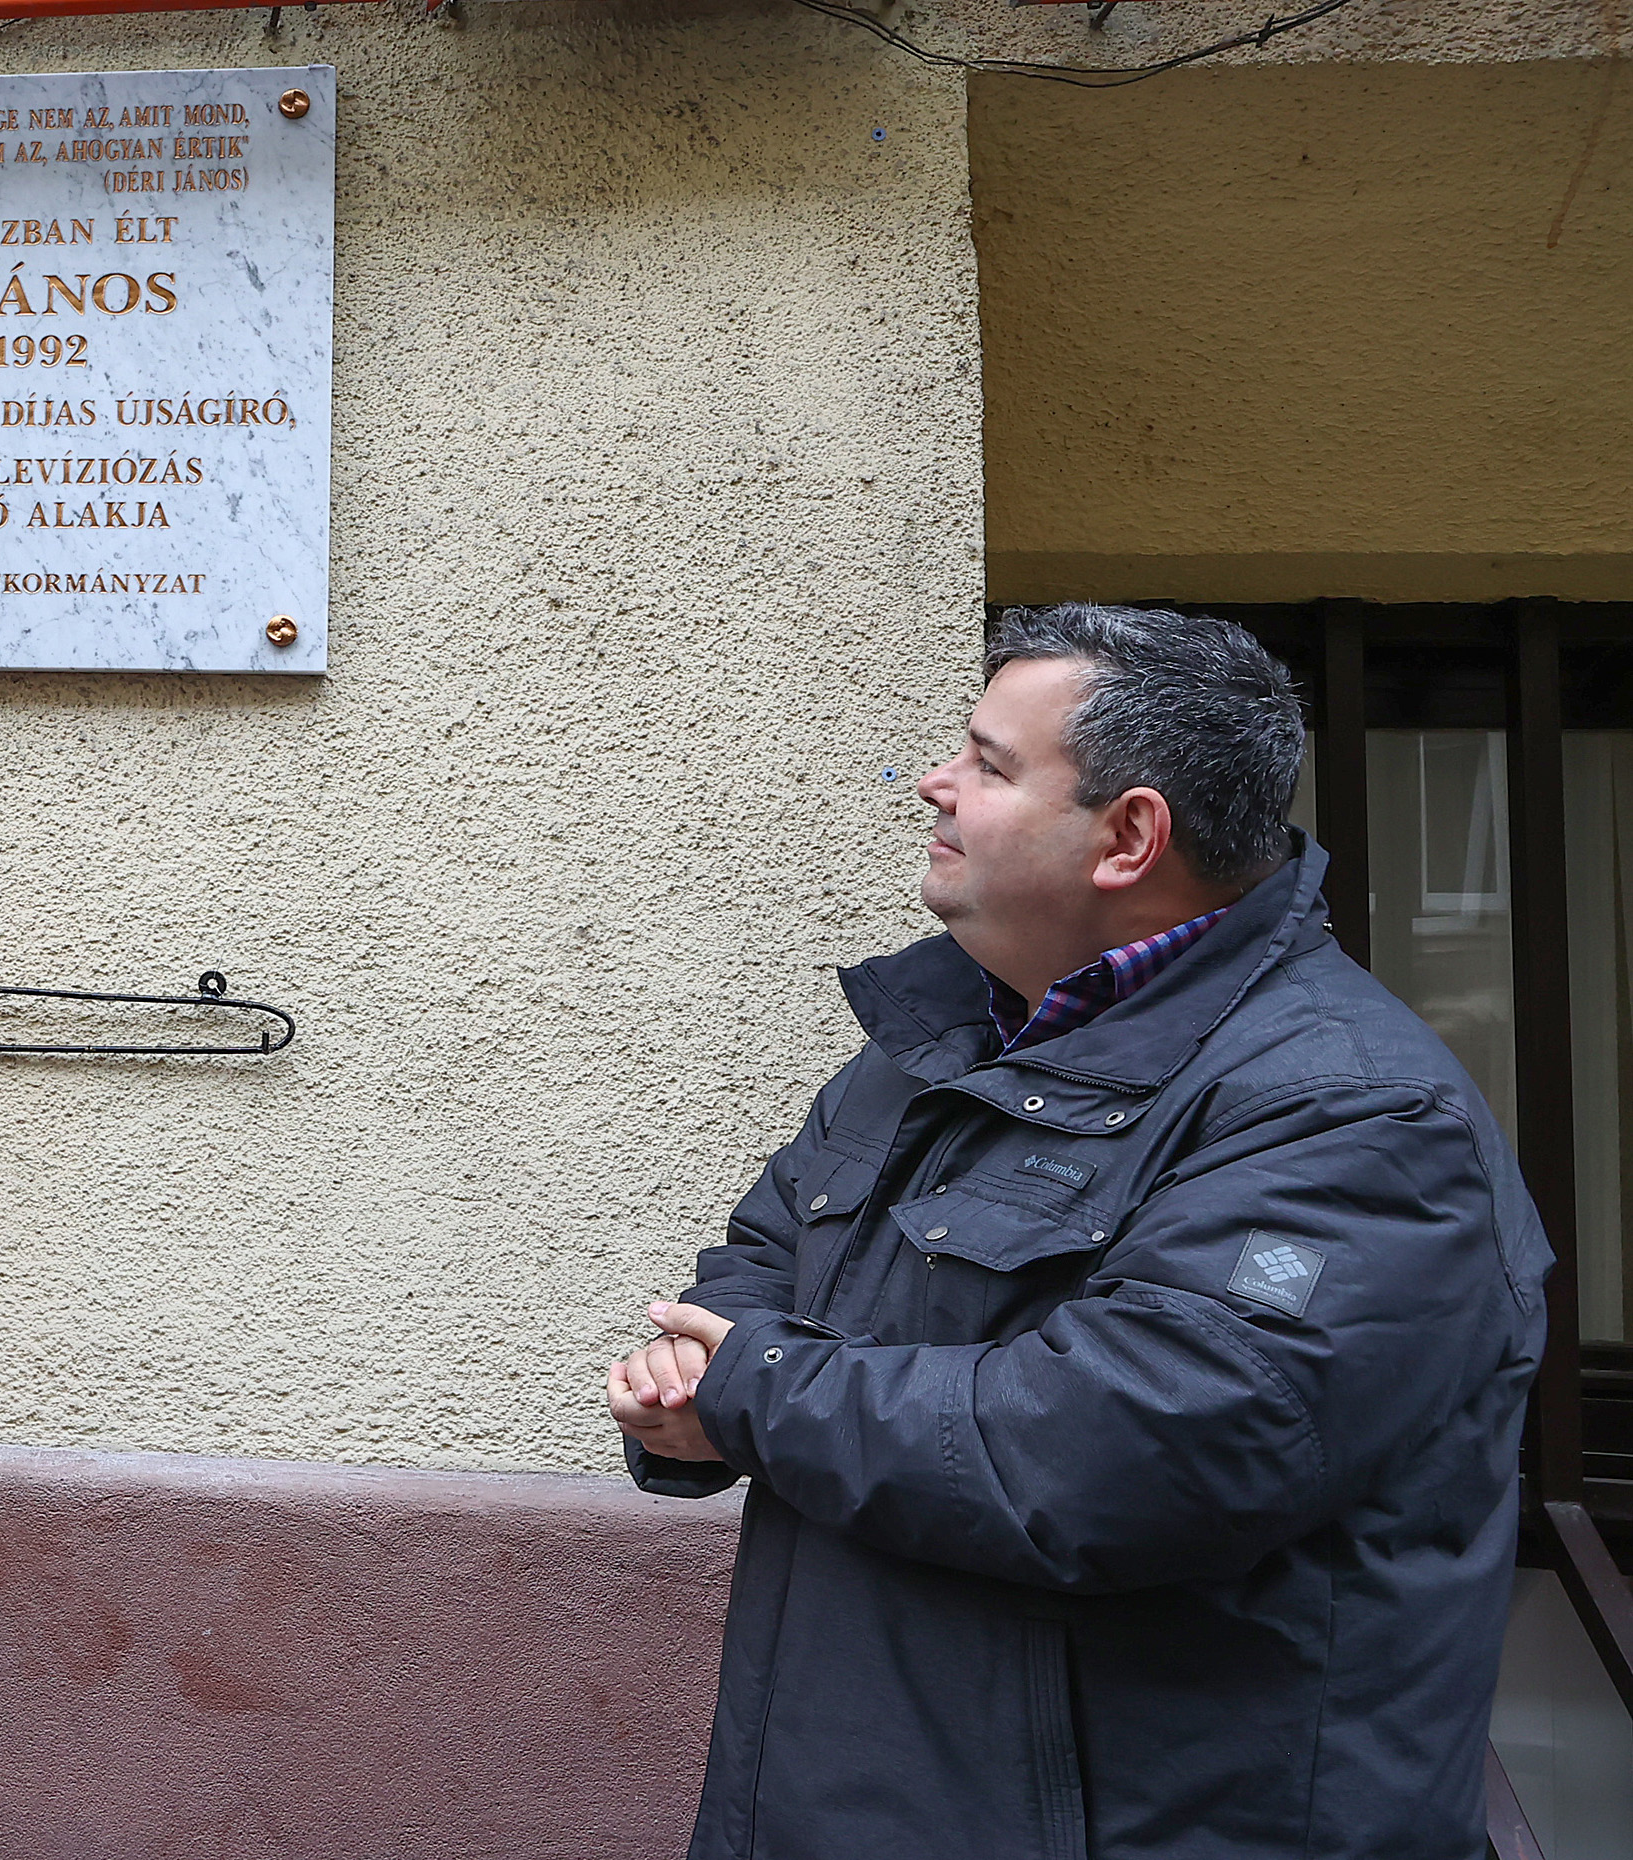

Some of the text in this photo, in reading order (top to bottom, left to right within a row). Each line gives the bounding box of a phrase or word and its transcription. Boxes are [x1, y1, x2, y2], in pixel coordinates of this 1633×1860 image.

[29, 107, 74, 130] NEM
[83, 106, 115, 131] AZ,
[119, 105, 174, 128] AMIT
[183, 103, 250, 129] MOND,
[14, 140, 48, 166] AZ,
[55, 137, 164, 162] AHOGYAN
[173, 130, 250, 159] ÉRTIK"
[104, 163, 250, 195] (DÉRI JÁNOS)
[114, 209, 179, 244] ÉLT
[116, 389, 297, 431] ÚJSÁGÍRÓ,
[26, 501, 171, 529] ALAKJA
[1034, 1157, 1083, 1181] Columbia
[1243, 1276, 1297, 1302] Columbia
